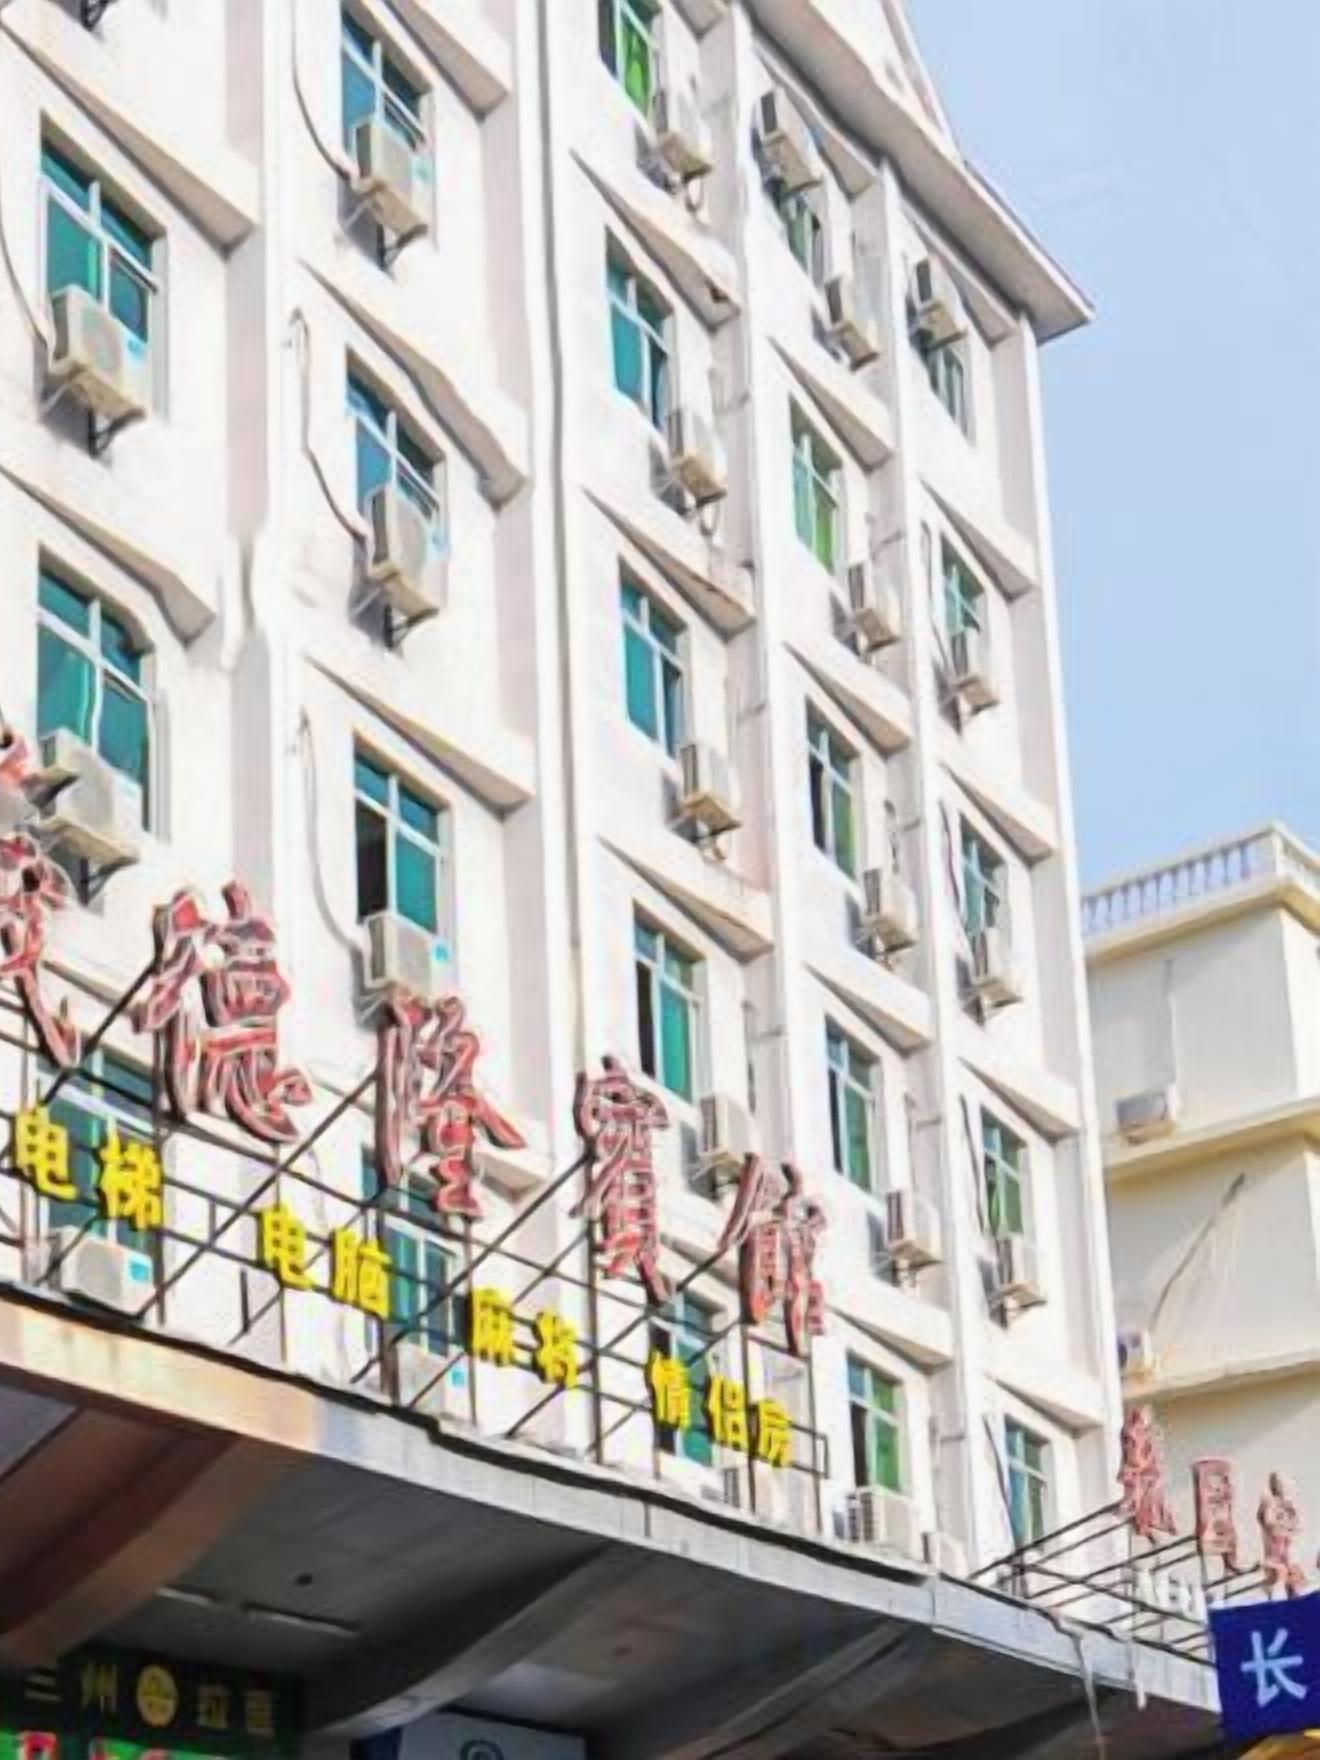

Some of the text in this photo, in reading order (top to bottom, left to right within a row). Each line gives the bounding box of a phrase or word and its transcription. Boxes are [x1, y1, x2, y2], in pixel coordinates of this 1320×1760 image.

[14, 1100, 793, 1467] 电梯 电脑 麻将 情侣房
[1240, 1628, 1308, 1707] 长
